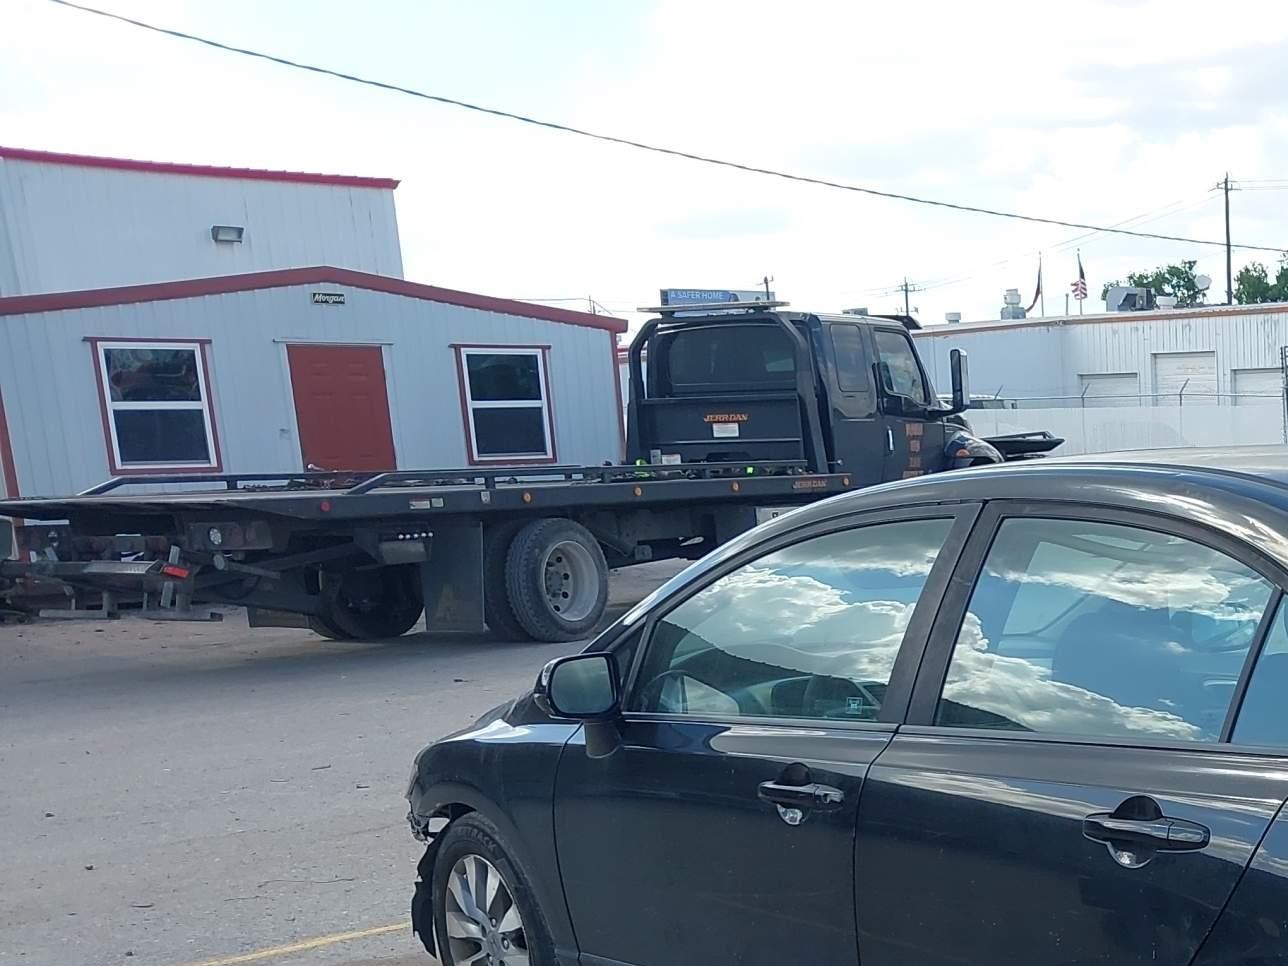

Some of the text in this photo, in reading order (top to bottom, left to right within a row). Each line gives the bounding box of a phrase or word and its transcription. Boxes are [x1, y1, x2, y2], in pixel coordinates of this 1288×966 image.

[314, 293, 345, 304] Morgan
[670, 291, 723, 300] A SAFER HOME
